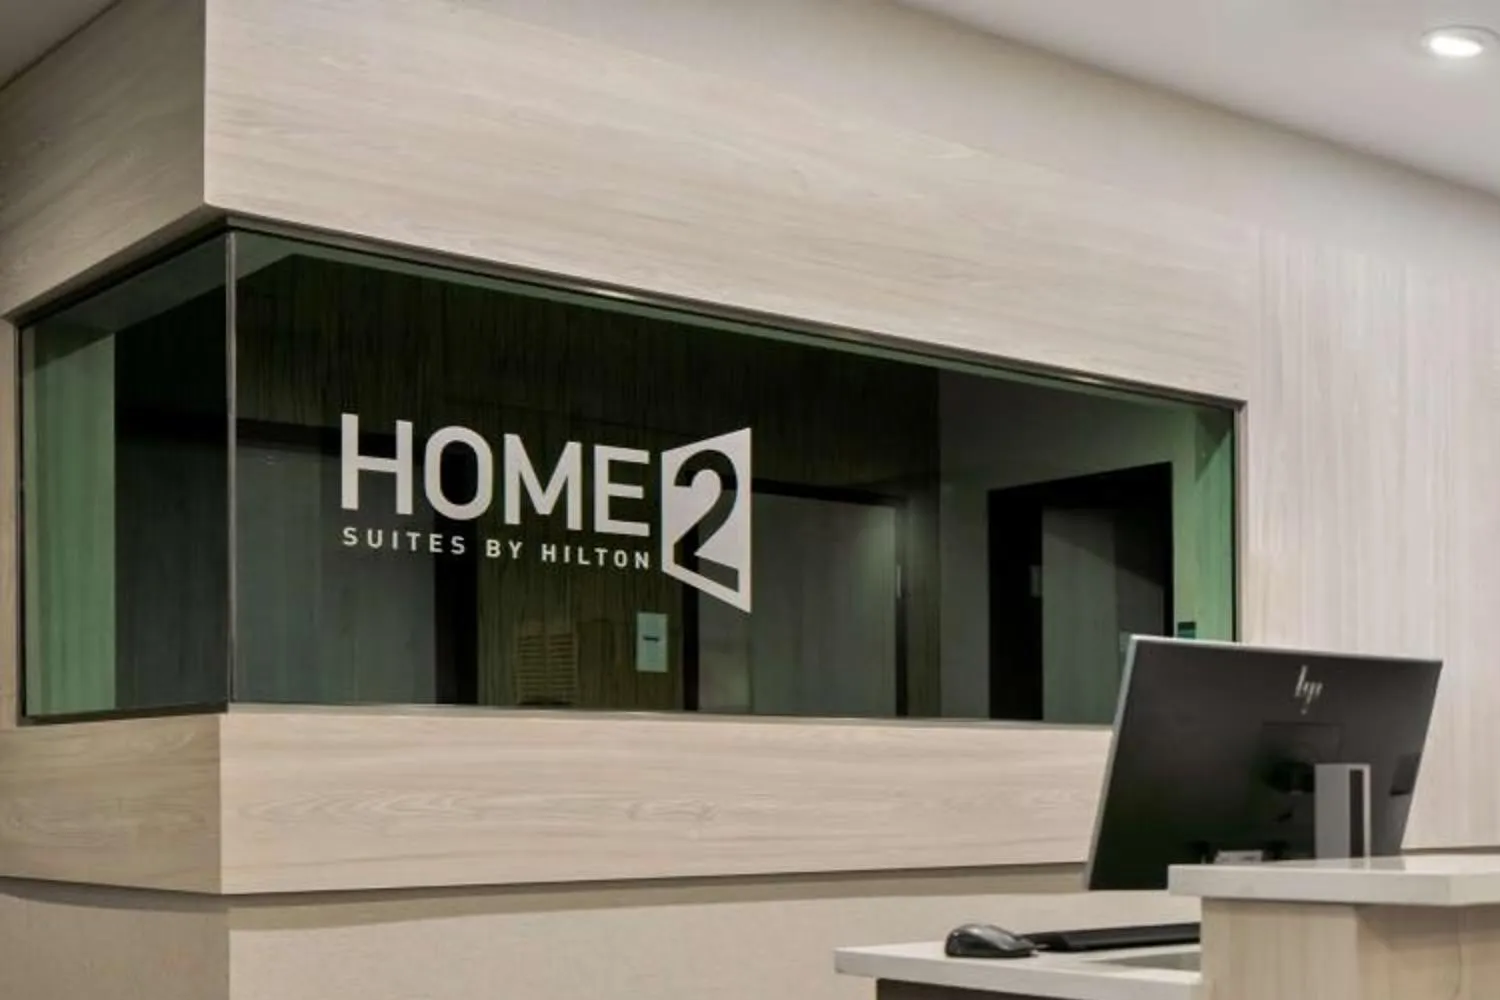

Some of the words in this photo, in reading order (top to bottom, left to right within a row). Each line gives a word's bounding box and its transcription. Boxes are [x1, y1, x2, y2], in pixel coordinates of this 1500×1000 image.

[342, 527, 466, 555] SUITES
[485, 539, 524, 559] BY
[541, 543, 650, 569] HILTON
